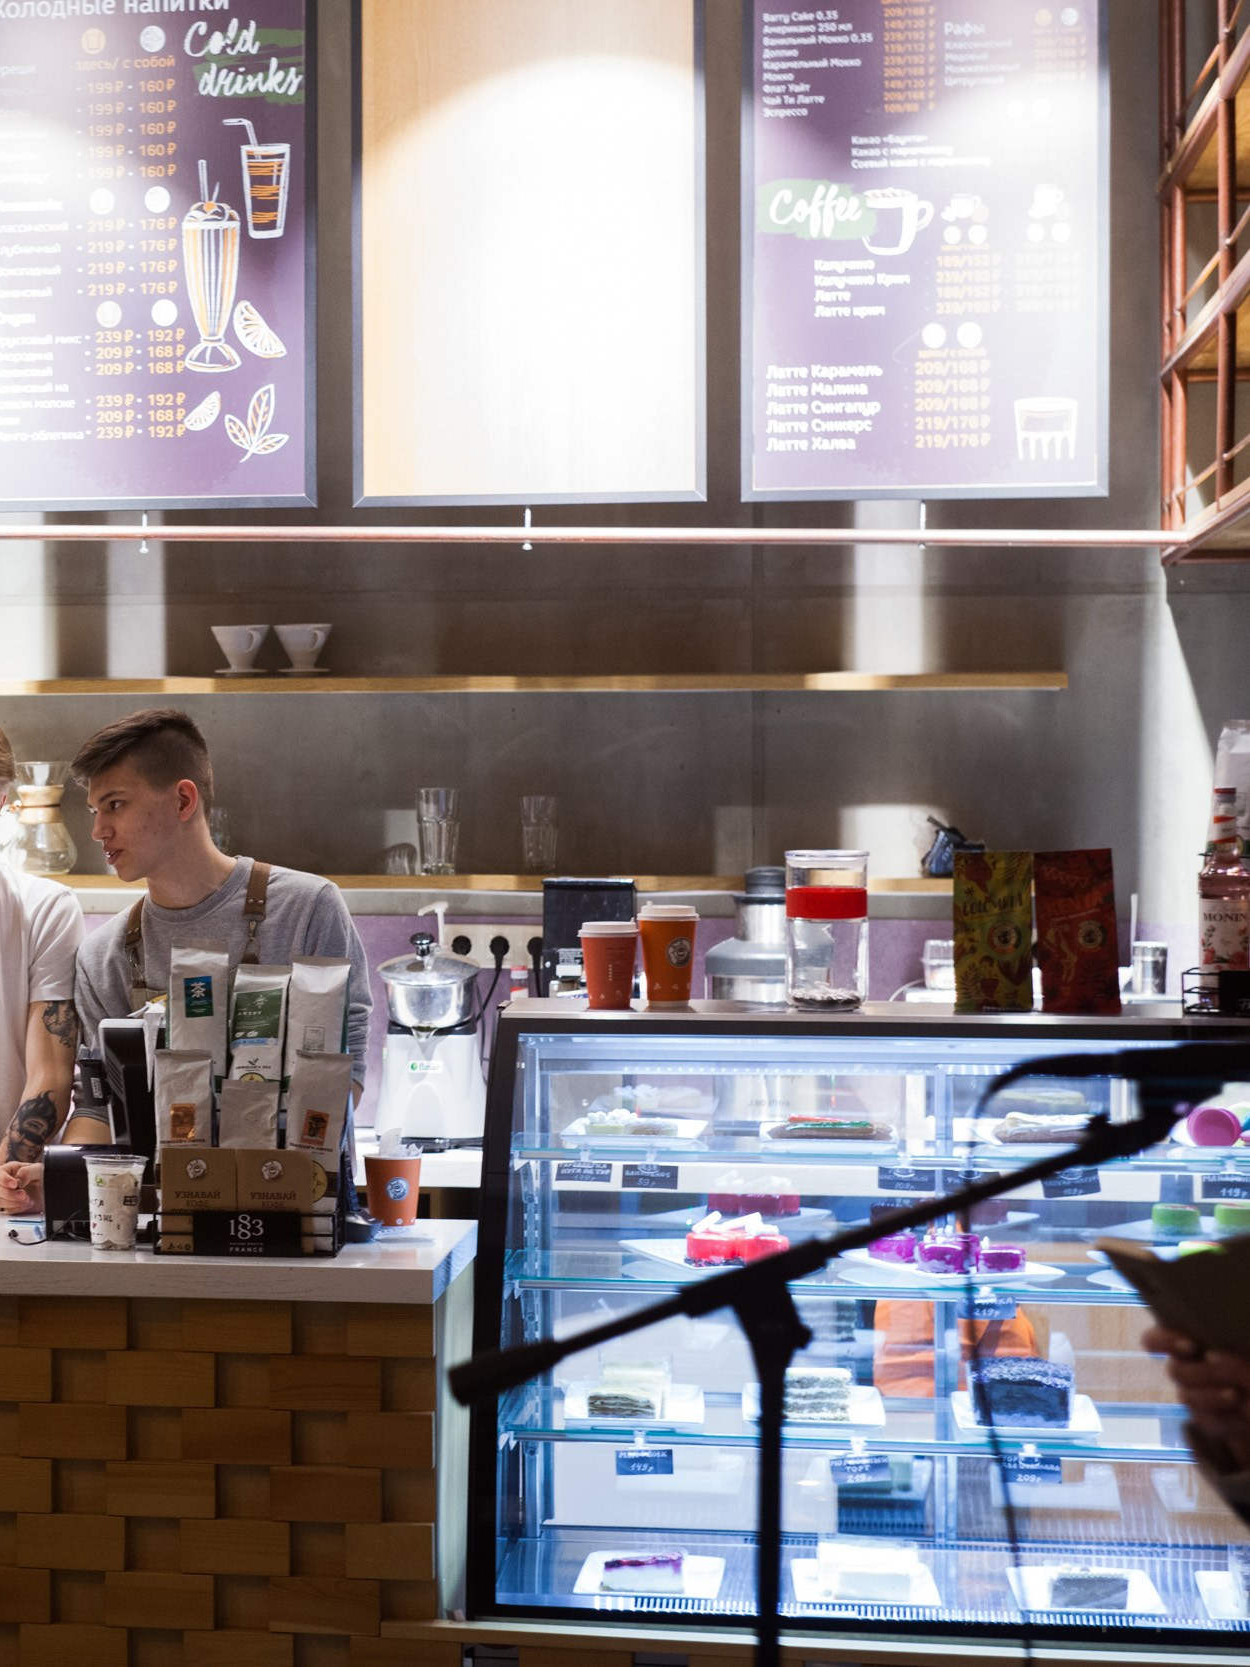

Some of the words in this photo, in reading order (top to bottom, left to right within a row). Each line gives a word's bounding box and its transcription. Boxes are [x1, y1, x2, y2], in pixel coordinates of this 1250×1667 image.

[123, 0, 230, 14] напитки
[944, 21, 985, 37] Рафы
[134, 55, 176, 68] собой
[198, 56, 302, 97] drinks
[769, 184, 862, 238] Coffee
[1203, 912, 1248, 922] MONIN
[175, 1190, 220, 1198] УЗНАВАЙ
[250, 1191, 296, 1200] УЗНАВАЙ
